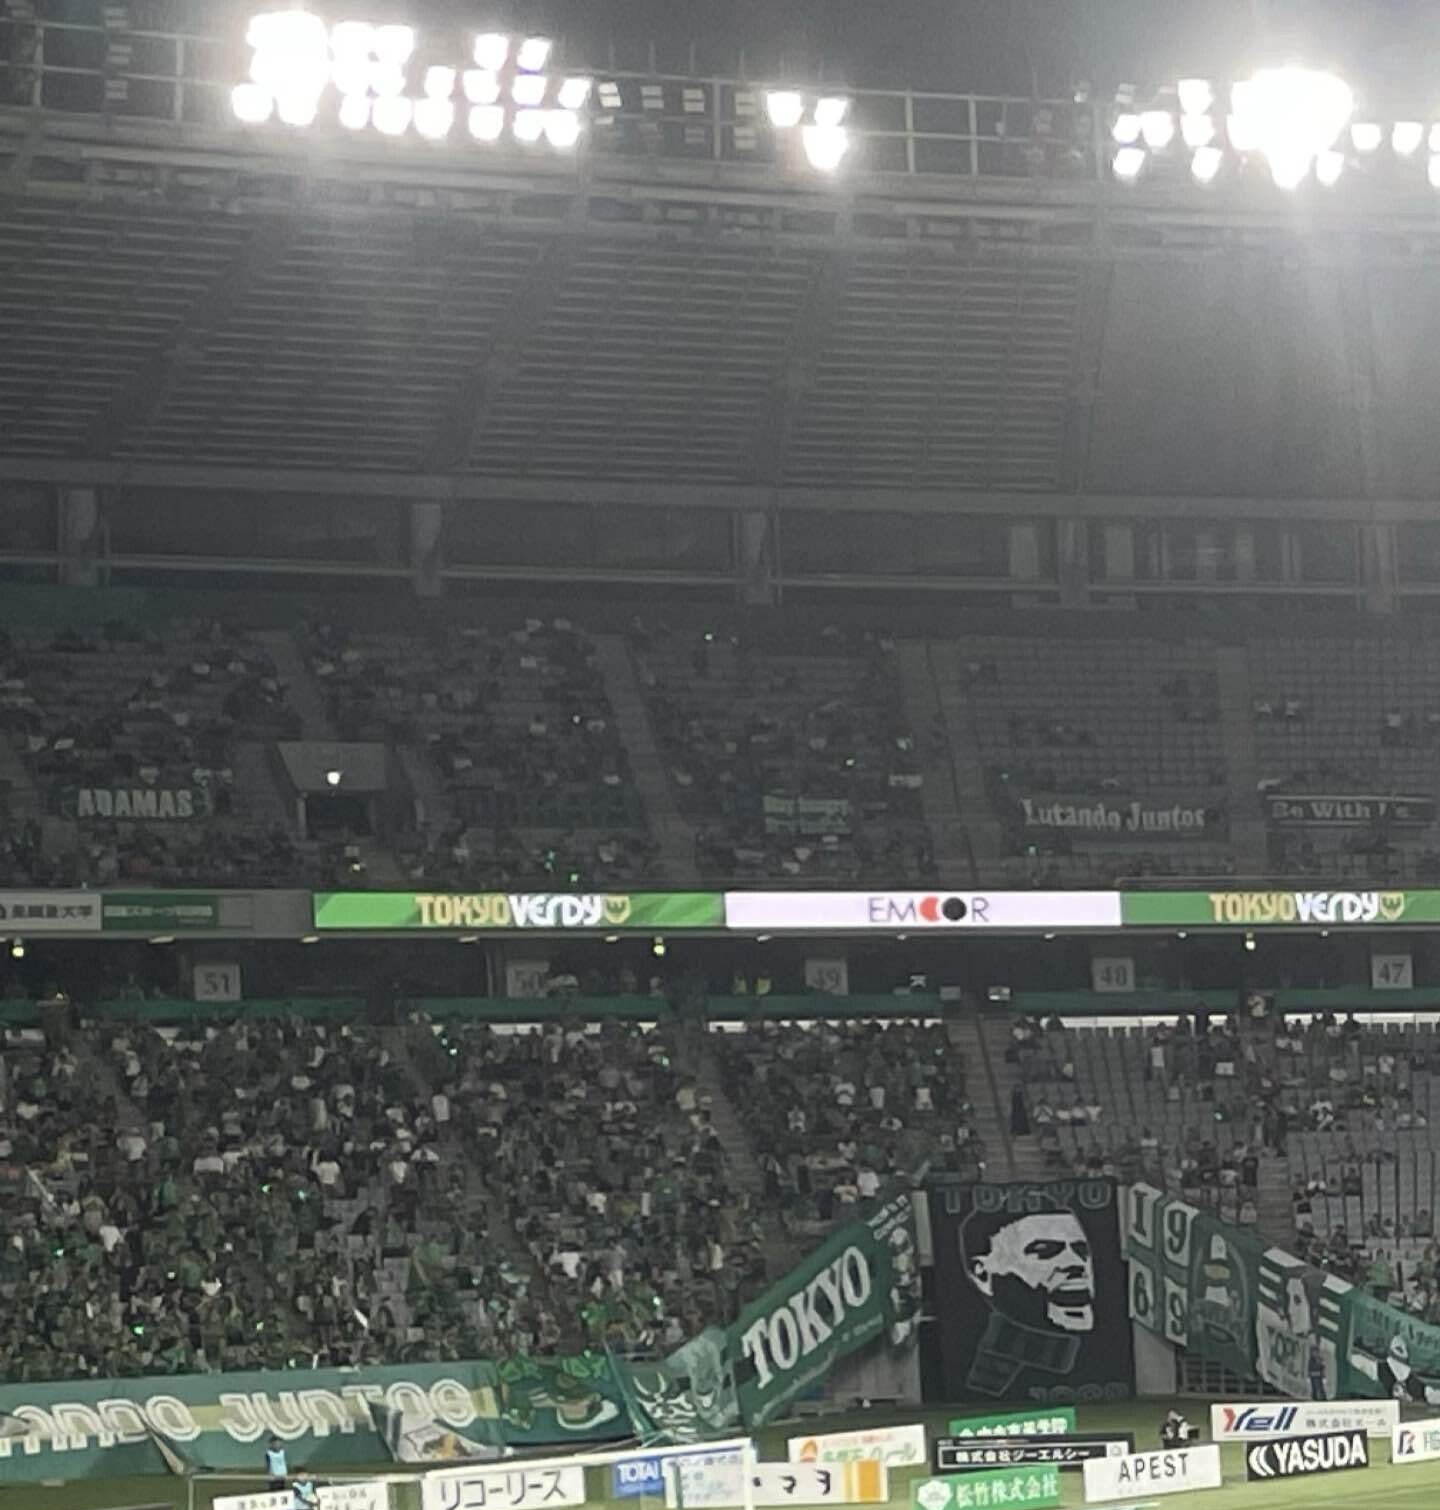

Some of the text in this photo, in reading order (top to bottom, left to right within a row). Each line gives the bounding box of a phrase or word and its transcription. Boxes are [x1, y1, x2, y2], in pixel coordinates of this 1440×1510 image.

[77, 788, 194, 820] ADAMAS
[1019, 798, 1206, 832] Lutando Juntos
[205, 973, 232, 994] 51
[1101, 963, 1128, 986] 48
[1378, 962, 1405, 985] 47
[741, 1246, 871, 1391] TOKYO
[219, 1379, 478, 1443] JUNTOS
[1118, 1453, 1190, 1483] APEST
[1273, 1434, 1367, 1474] YASUDA
